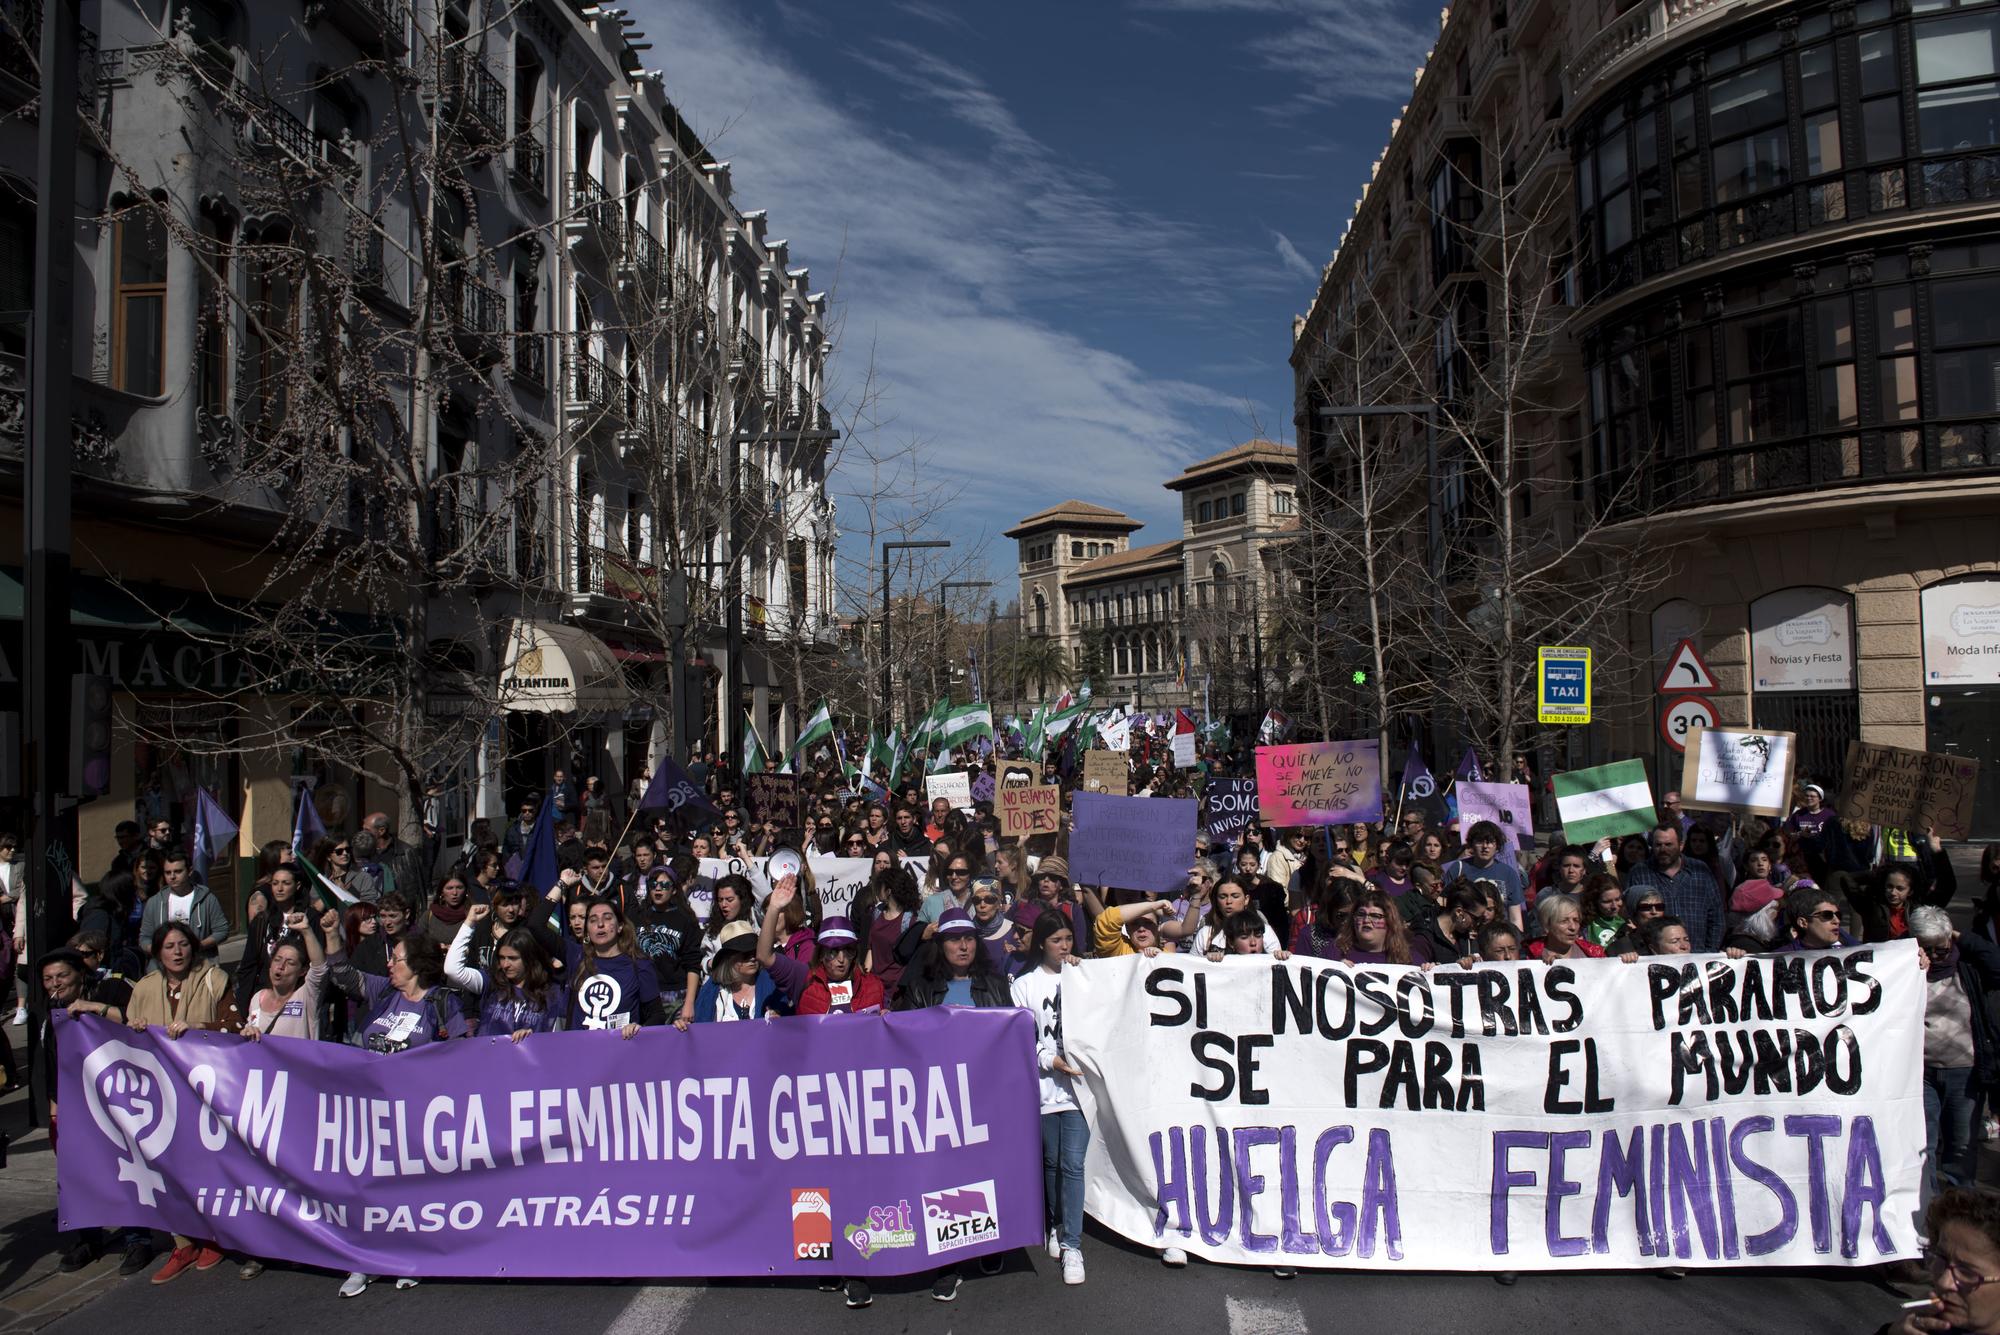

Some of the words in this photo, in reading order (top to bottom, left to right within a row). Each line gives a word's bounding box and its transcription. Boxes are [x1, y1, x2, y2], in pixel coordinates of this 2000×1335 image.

[1770, 655, 1803, 664] Novias
[1804, 657, 1811, 665] y
[1813, 653, 1842, 663] Fiesta
[1947, 645, 1980, 655] Moda
[1551, 686, 1579, 697] TAXI
[1674, 715, 1707, 734] 30
[1334, 752, 1354, 764] NO
[1857, 747, 1956, 776] INTENTARON
[1275, 772, 1294, 781] SE
[1302, 767, 1336, 781] MUEVE
[1346, 766, 1362, 777] NO
[677, 781, 699, 799] CGT
[1006, 779, 1029, 789] MUJER
[1232, 781, 1254, 792] NO
[1332, 782, 1360, 796] SUS
[1852, 781, 1868, 792] NO
[1914, 791, 1937, 803] QUE
[1003, 790, 1016, 806] NO
[1020, 788, 1056, 806] ESTAMOS
[1210, 794, 1259, 812] SOMO
[1291, 795, 1349, 811] CADENAS
[1145, 967, 1208, 1030] SI
[1271, 965, 1584, 1040] NOSOTRAS
[1647, 949, 1883, 1031] PARAMOS
[1190, 1030, 1274, 1105] SE
[1344, 1038, 1485, 1112] PARA
[1544, 1038, 1615, 1114] EL
[1667, 1023, 1863, 1106] MUNDO
[314, 1092, 497, 1177] HUELGA
[510, 1077, 756, 1167] FEMINISTA
[768, 1062, 990, 1161] GENERAL
[1148, 1125, 1405, 1260] HUELGA
[1489, 1114, 1897, 1261] FEMINISTA
[298, 1194, 348, 1228] UN
[363, 1201, 484, 1233] PASO
[496, 1187, 696, 1228] ATRÁS!!!
[869, 1199, 913, 1232] sat
[870, 1232, 915, 1244] Sindicato
[936, 1215, 997, 1243] USTEA
[797, 1242, 830, 1258] CGT
[938, 1237, 964, 1251] ESPACIO
[964, 1231, 999, 1246] FEMINISTA
